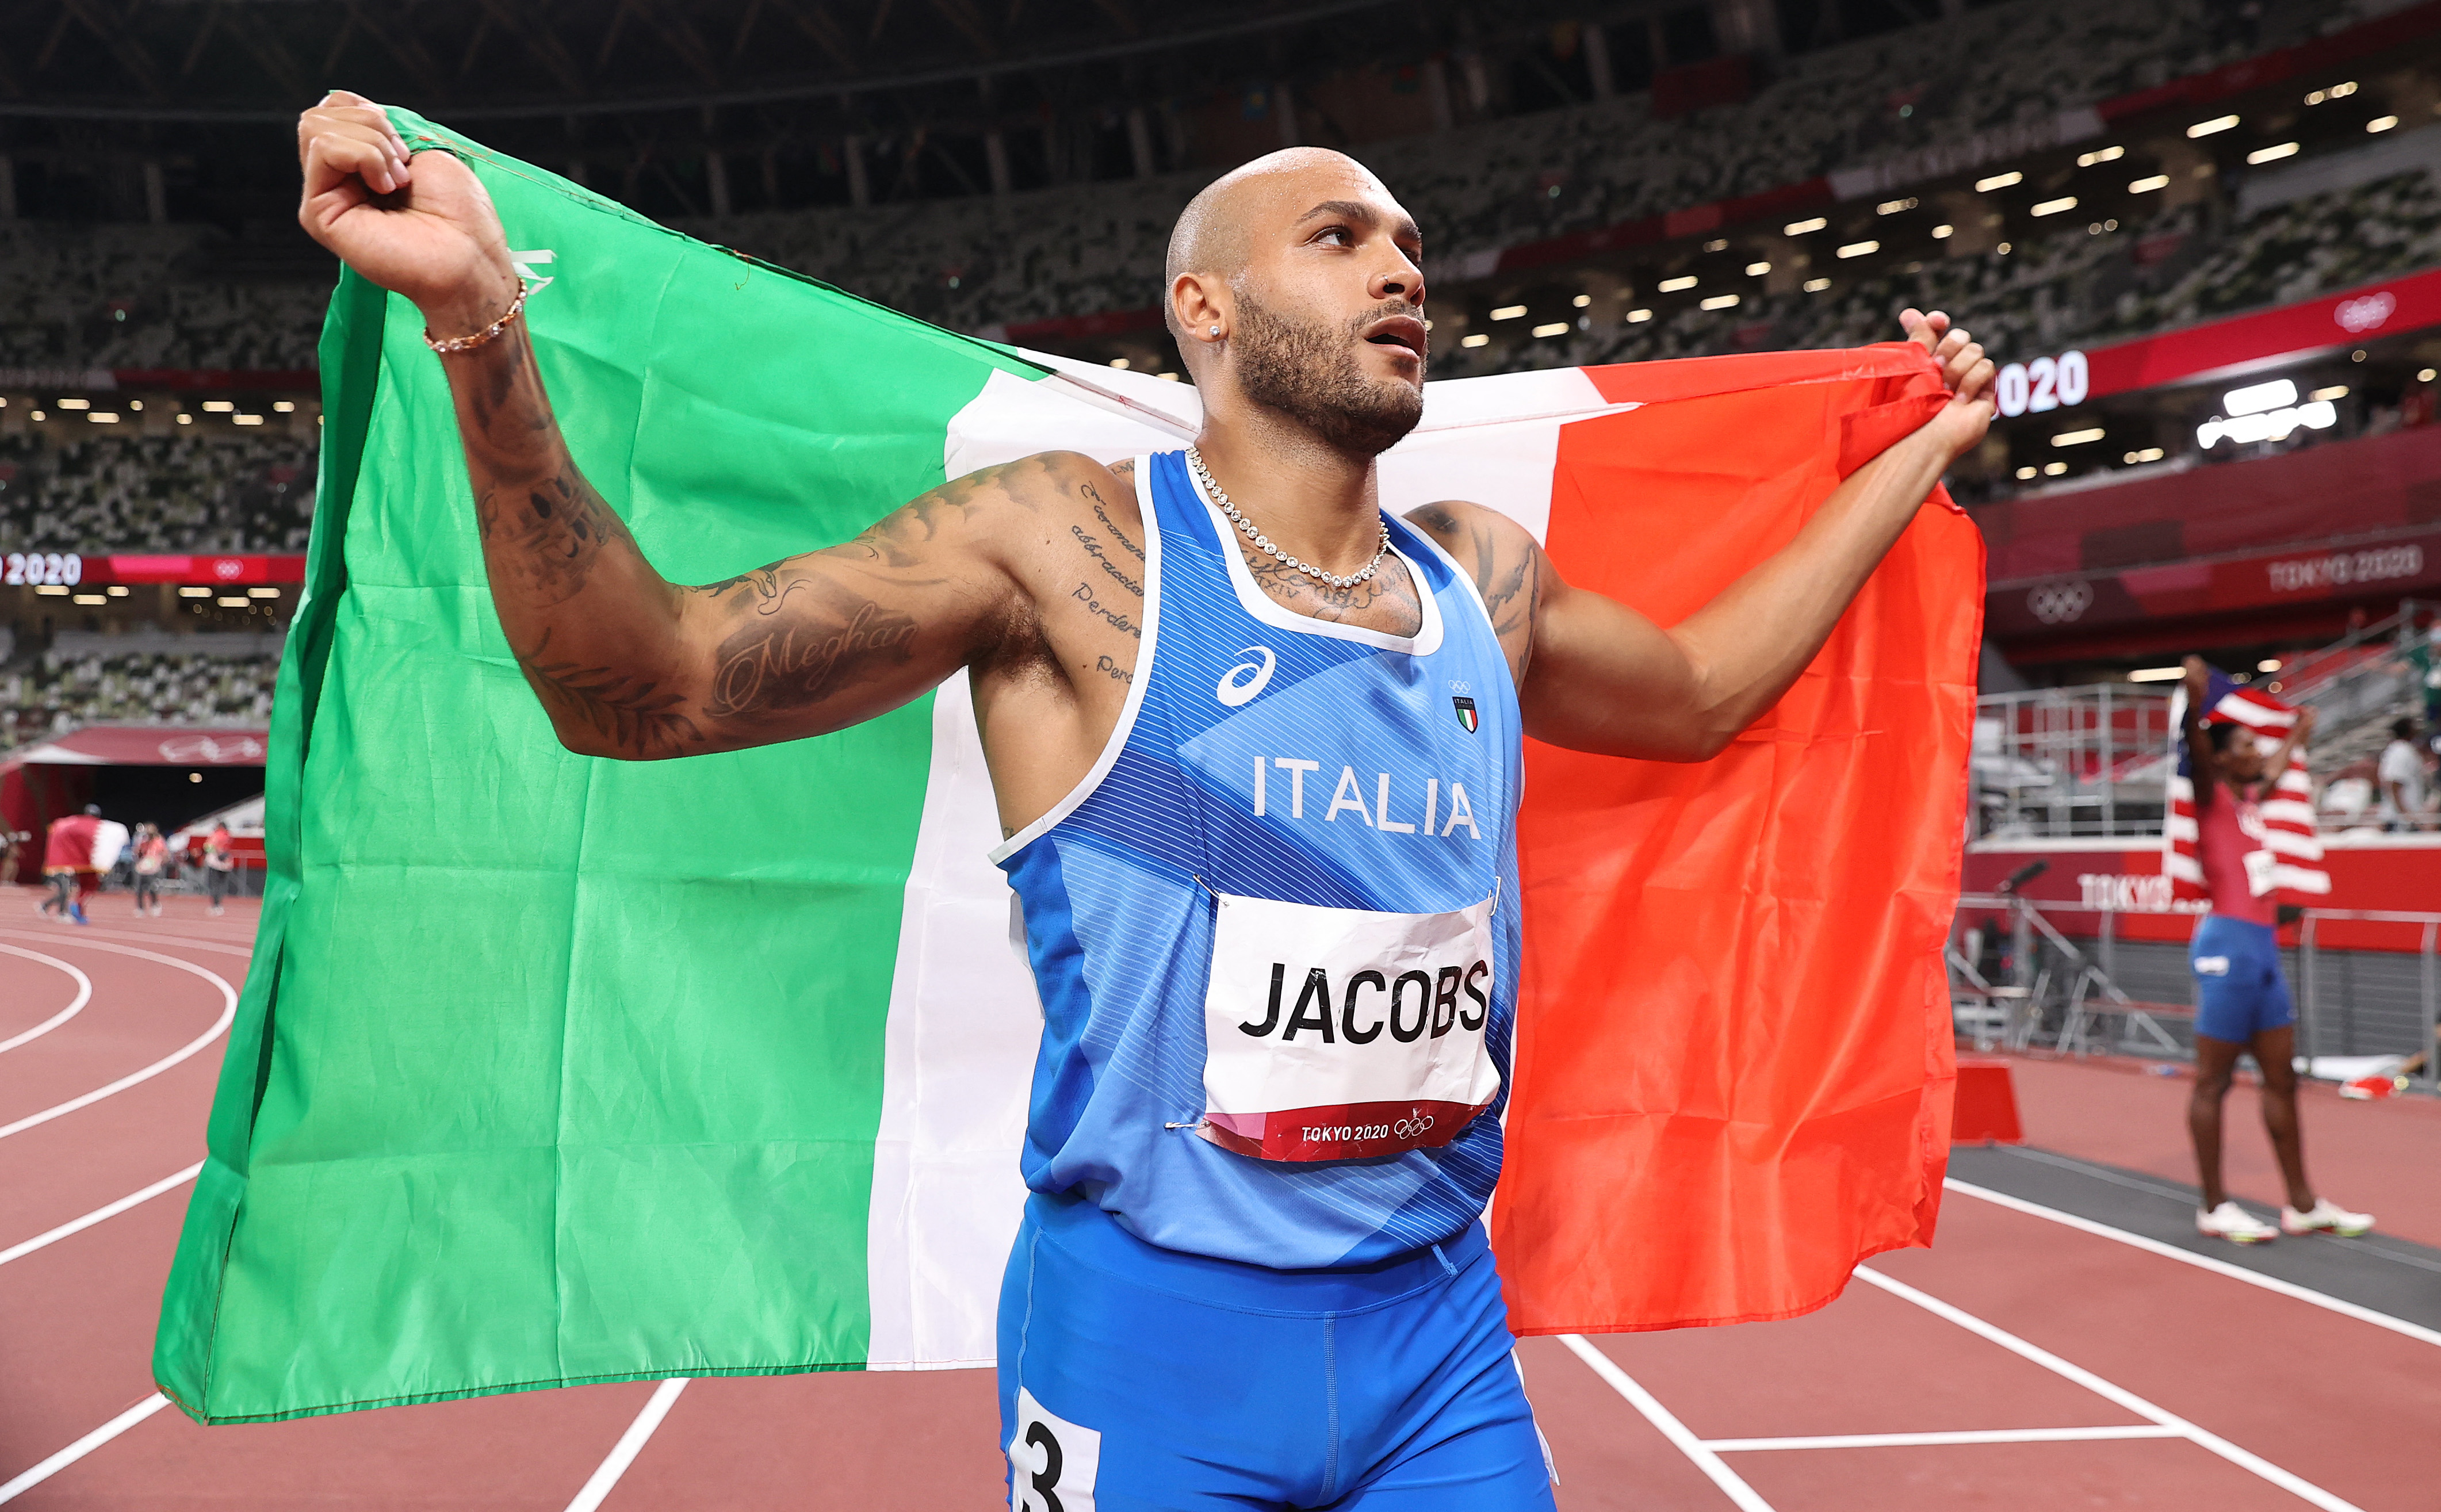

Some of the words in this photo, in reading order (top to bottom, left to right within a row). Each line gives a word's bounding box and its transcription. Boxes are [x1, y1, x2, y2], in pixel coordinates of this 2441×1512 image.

[1991, 350, 2089, 421] 020
[5, 552, 82, 586] 2020
[2268, 554, 2352, 592] TOKYO
[2353, 545, 2424, 583] 2020
[713, 602, 919, 717] Meghan
[1254, 756, 1482, 840] ITALIA
[1238, 959, 1489, 1045] JACOBS
[1302, 1126, 1351, 1142] TOKYO
[1354, 1124, 1389, 1140] 2020
[1021, 1421, 1065, 1512] 3
